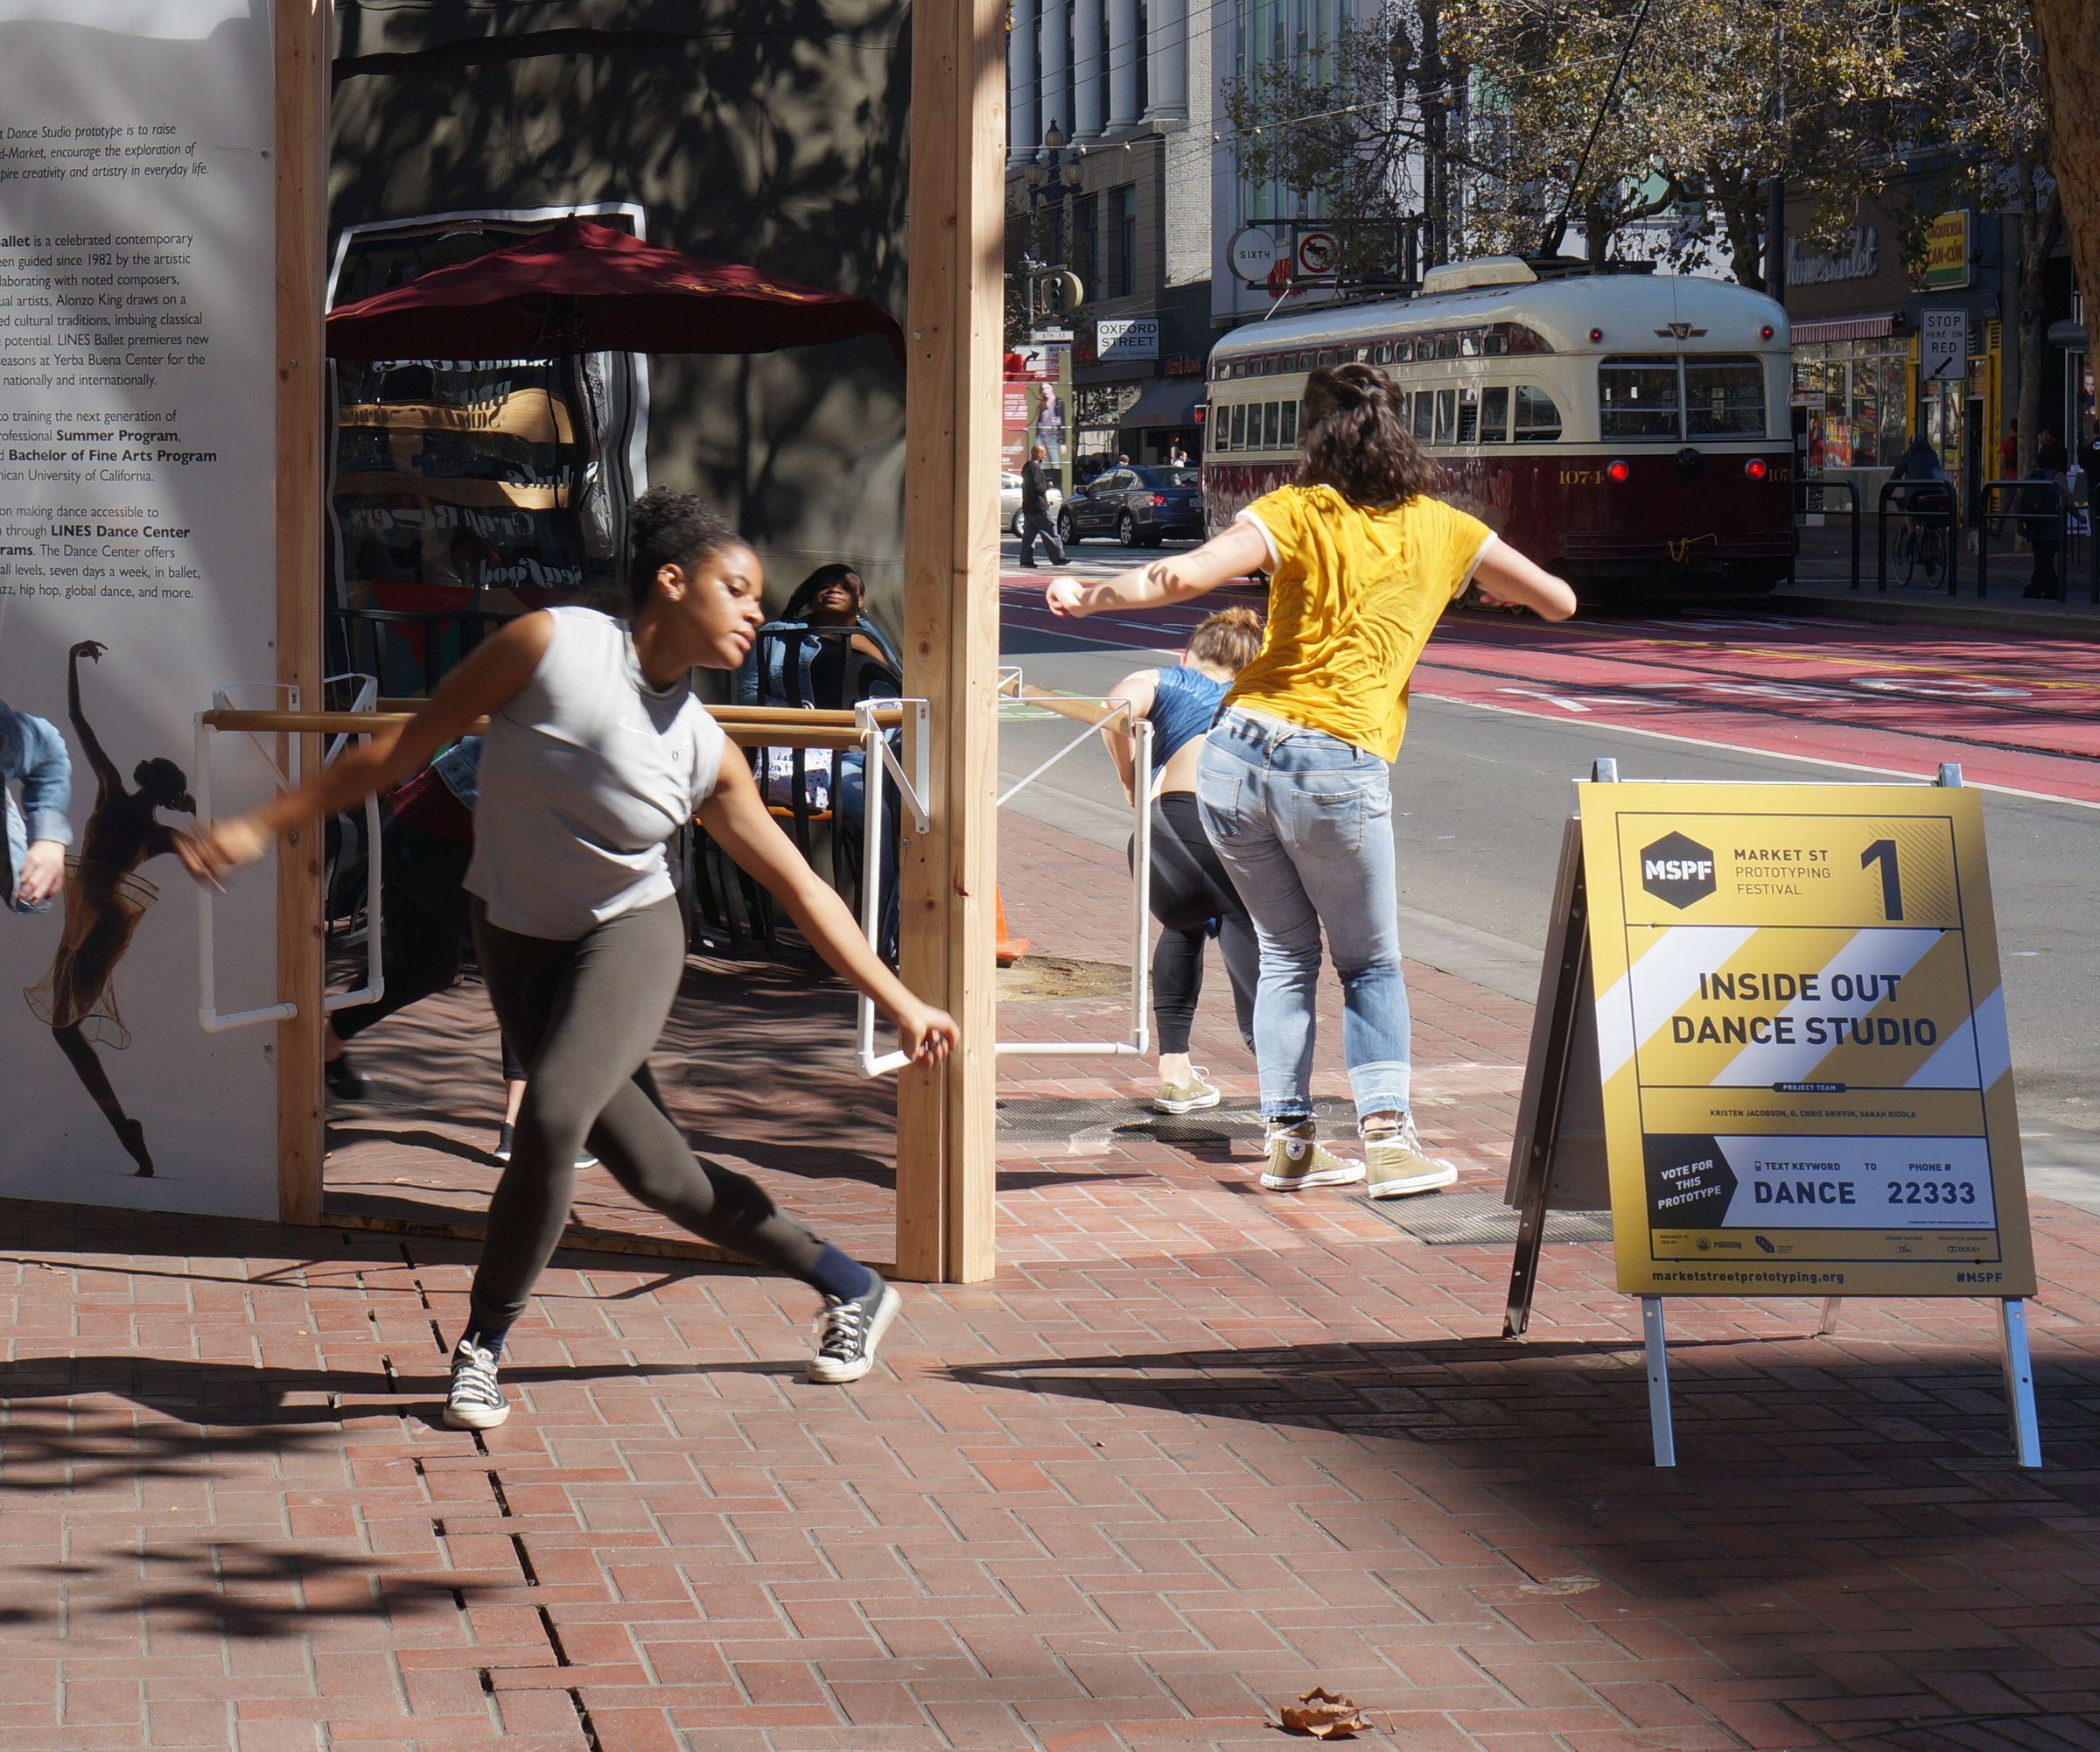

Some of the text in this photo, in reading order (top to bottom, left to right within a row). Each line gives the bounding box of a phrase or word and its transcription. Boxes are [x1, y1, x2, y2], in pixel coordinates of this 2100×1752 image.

[7, 127, 38, 140] Dance
[42, 125, 72, 139] Studio
[75, 126, 122, 142] prototype
[126, 123, 134, 137] is
[138, 124, 149, 136] to
[152, 123, 176, 136] raise
[50, 148, 102, 162] encourage
[105, 144, 121, 157] the
[125, 143, 181, 160] exploration
[185, 141, 197, 158] of
[22, 162, 209, 183] creativity and artistry in everyday life.
[34, 232, 193, 249] is a celebrated contemporary
[18, 252, 191, 271] guided since 1982 by the artistic
[1240, 250, 1270, 259] SIXTH
[54, 273, 78, 286] with
[81, 272, 113, 286] noted
[117, 276, 179, 290] composers,
[16, 292, 186, 310] artists, Alonzo King draws on a
[14, 312, 202, 329] cultural traditions, imbuing classical
[1100, 324, 1157, 334] OXFORD
[1928, 316, 1961, 327] STOP
[5, 333, 53, 351] potential.
[58, 333, 90, 347] LINES
[94, 333, 124, 346] Ballet
[128, 333, 182, 350] premieres
[186, 335, 209, 345] new
[1102, 336, 1155, 347] STREET
[1931, 342, 1956, 354] RED
[39, 352, 206, 366] at Yerba Buena Center for the
[4, 372, 157, 390] nationally and internationally.
[12, 409, 52, 426] training
[55, 409, 73, 422] the
[76, 410, 101, 422] next
[103, 409, 162, 426] generation
[165, 409, 178, 422] of
[57, 428, 181, 445] Summer Program,
[9, 448, 66, 461] Bachelor
[71, 448, 85, 461] of
[89, 448, 117, 461] Fine
[122, 448, 152, 462] Arts
[157, 449, 217, 466] Program
[28, 468, 154, 486] University of California.
[1559, 470, 1603, 485] 1074
[17, 503, 53, 521] making
[57, 503, 88, 517] dance
[91, 504, 144, 518] accessible
[147, 507, 159, 518] to
[6, 523, 47, 541] through
[51, 523, 92, 537] LINES
[96, 524, 138, 537] Dance
[143, 525, 191, 538] Center
[39, 543, 176, 558] The Dance Center offers
[0, 562, 201, 581] all levels, seven days a week, in ballet,
[19, 582, 194, 600] hip hop, global dance, and more.
[1734, 849, 1829, 862] MARKET ST
[1645, 859, 1712, 880] MSPF
[1735, 866, 1831, 879] PROTOTYPING
[1737, 884, 1802, 895] FESTIVAL
[1860, 839, 1904, 922] 1
[1699, 972, 1901, 1002] INSIDE OUT
[1672, 1016, 1937, 1046] DANCE STUDIO
[1745, 1110, 1788, 1118] JACOBSON,
[1824, 1111, 1858, 1119] GRIFFIN,
[1661, 1159, 1714, 1181] VOTE FOR
[1765, 1162, 1789, 1171] TEXT
[1792, 1162, 1840, 1172] KEYWORD
[1908, 1163, 1942, 1172] PHONE
[1944, 1163, 1951, 1172] #
[1676, 1176, 1702, 1190] THIS
[1657, 1185, 1722, 1209] PROTOTYPE
[1754, 1181, 1976, 1205] DANCE 22333
[1652, 1270, 2003, 1284] marketstreetprototyping.org #MSPF
